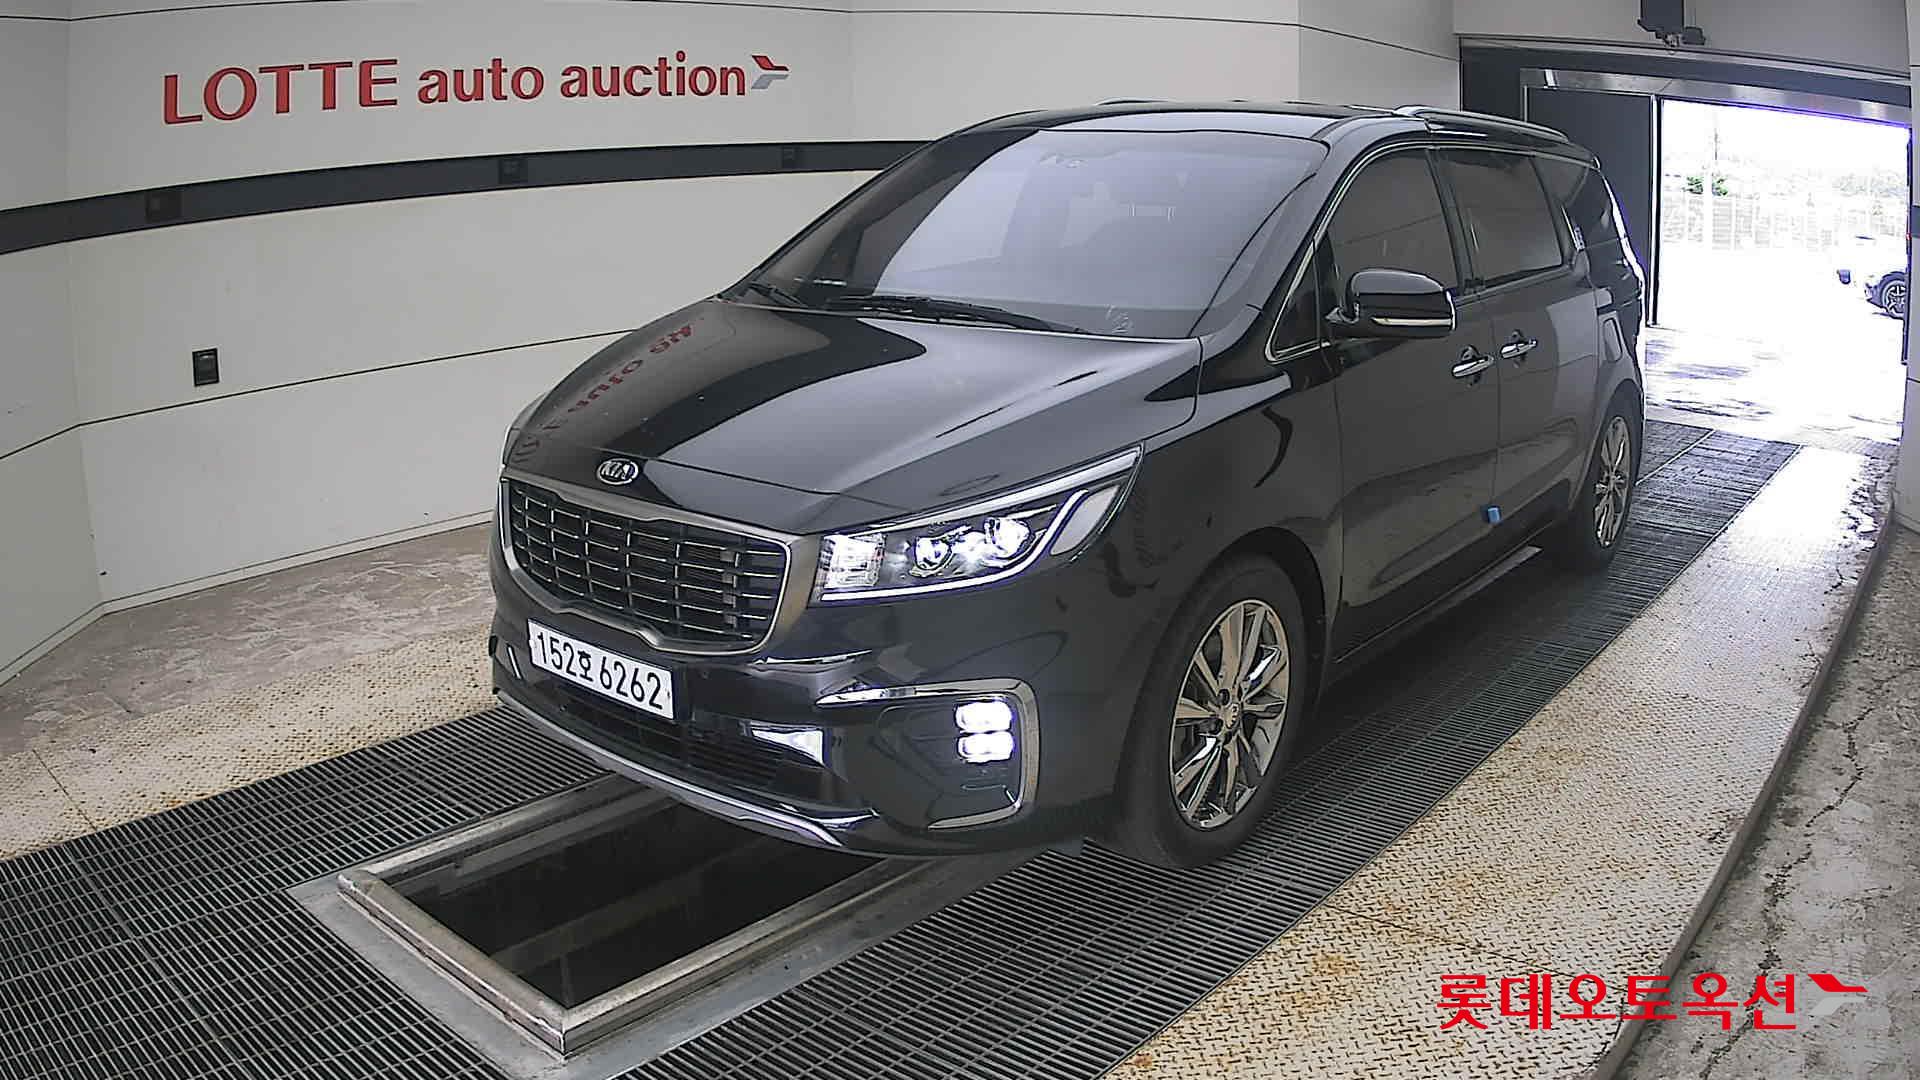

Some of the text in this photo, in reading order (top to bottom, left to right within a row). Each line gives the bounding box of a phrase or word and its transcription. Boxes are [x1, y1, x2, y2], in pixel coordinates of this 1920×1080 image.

[163, 50, 746, 125] LOTTE auto auction
